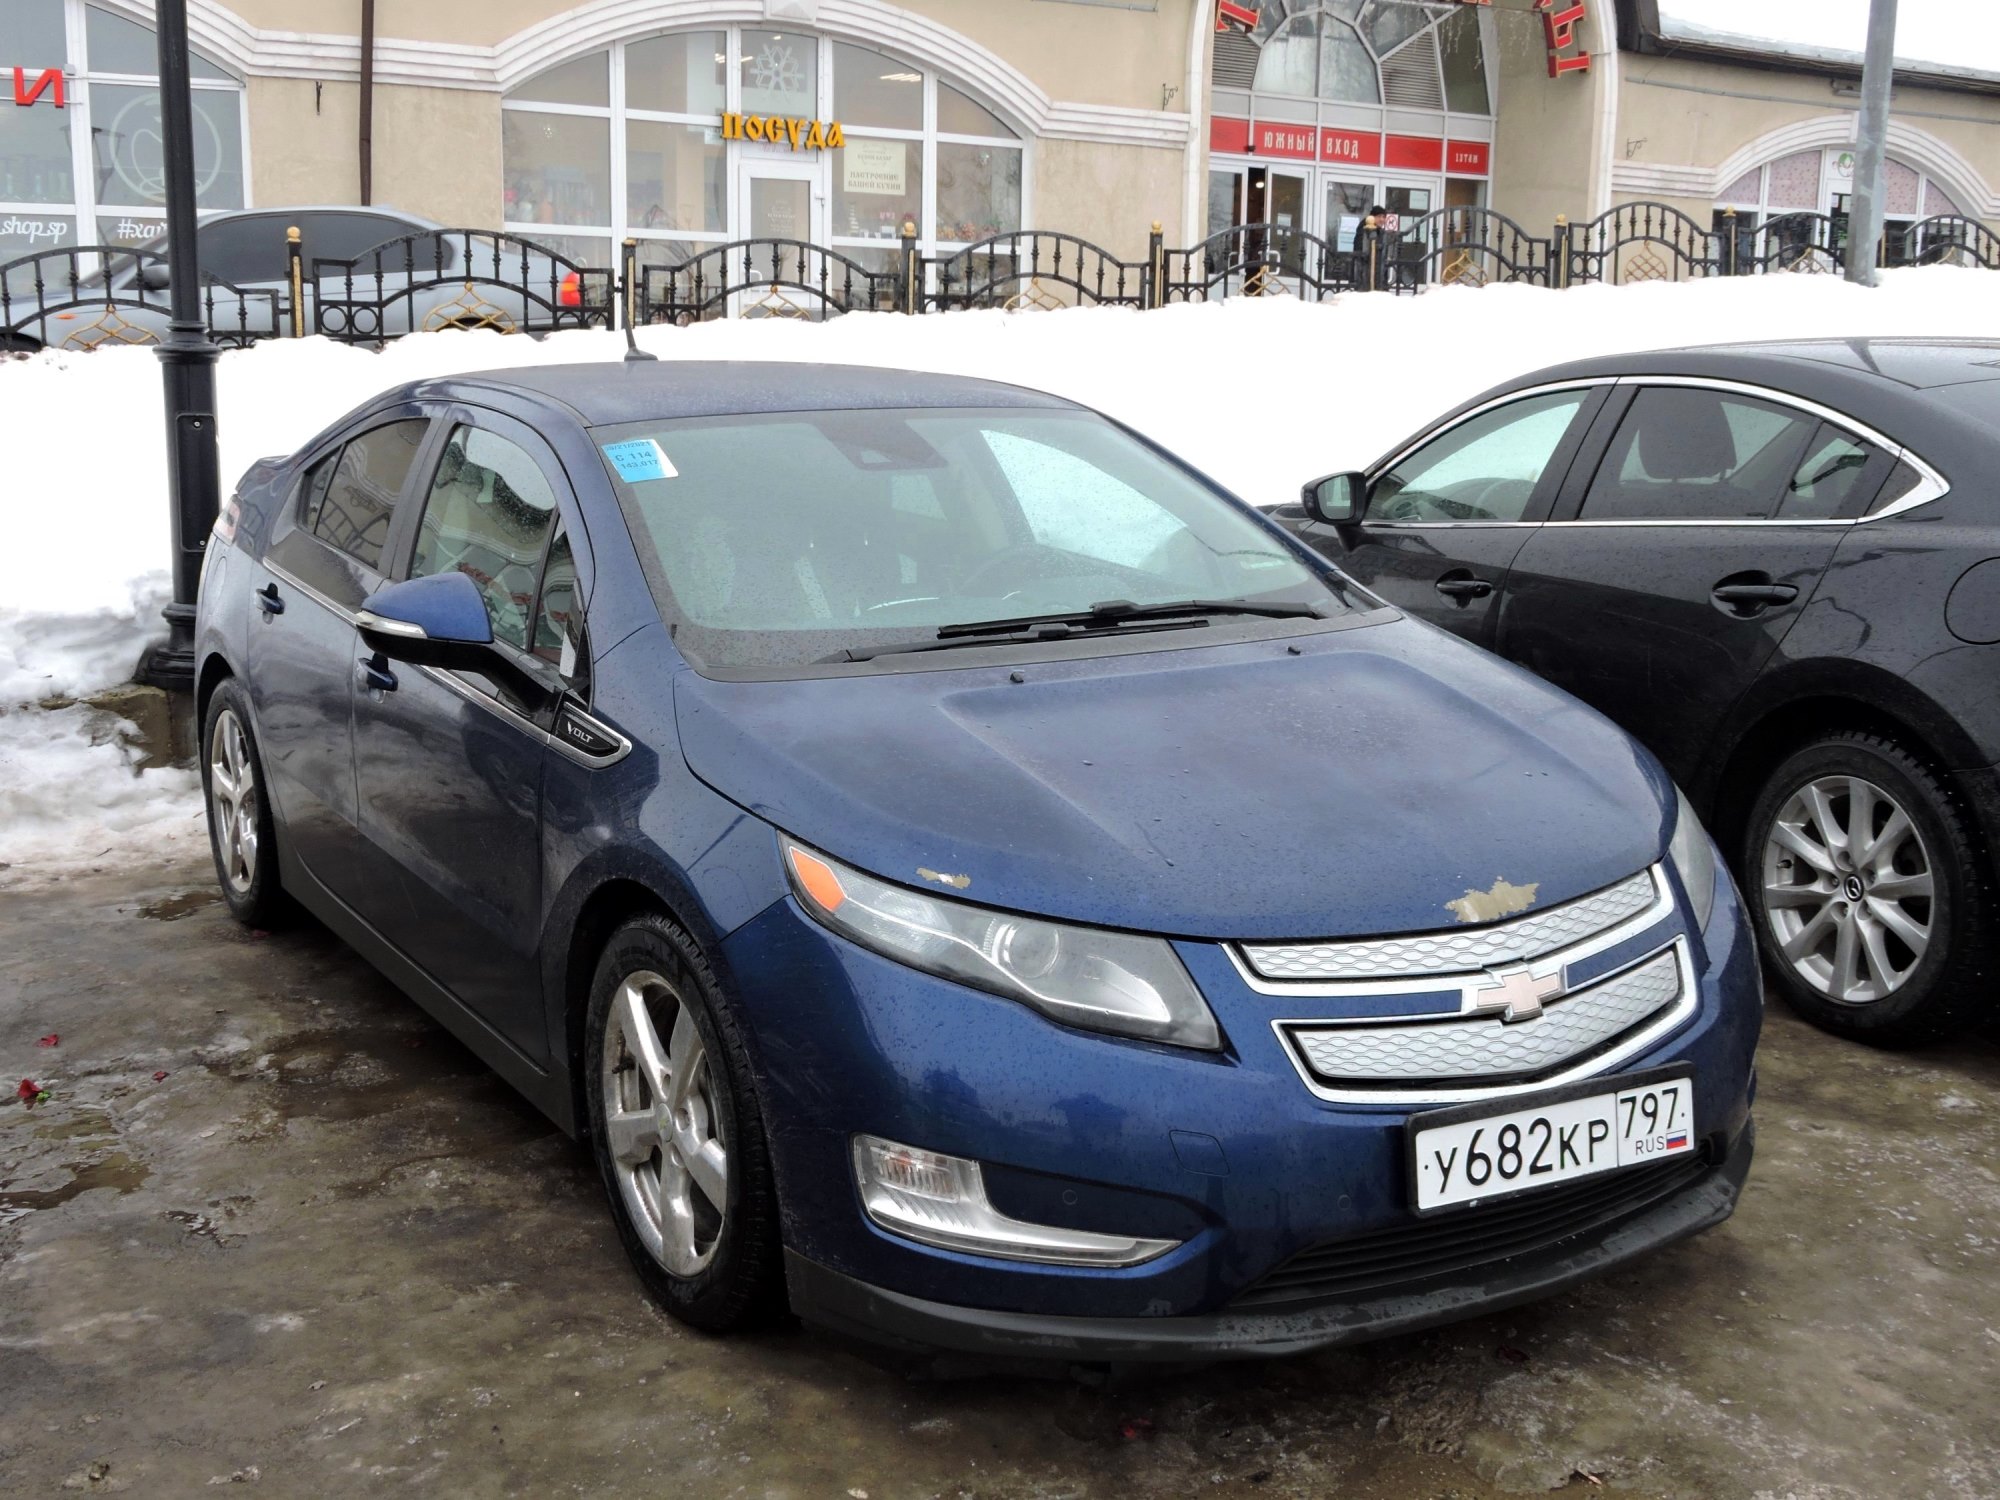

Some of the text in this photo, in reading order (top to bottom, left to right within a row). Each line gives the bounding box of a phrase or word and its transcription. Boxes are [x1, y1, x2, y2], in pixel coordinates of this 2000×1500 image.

[721, 112, 846, 154] ПОСУДА
[1264, 131, 1359, 159] ЮЖНЫЙ ВХОД
[567, 721, 594, 743] VOLT
[1619, 1086, 1680, 1139] 797
[1635, 1135, 1665, 1156] RUS
